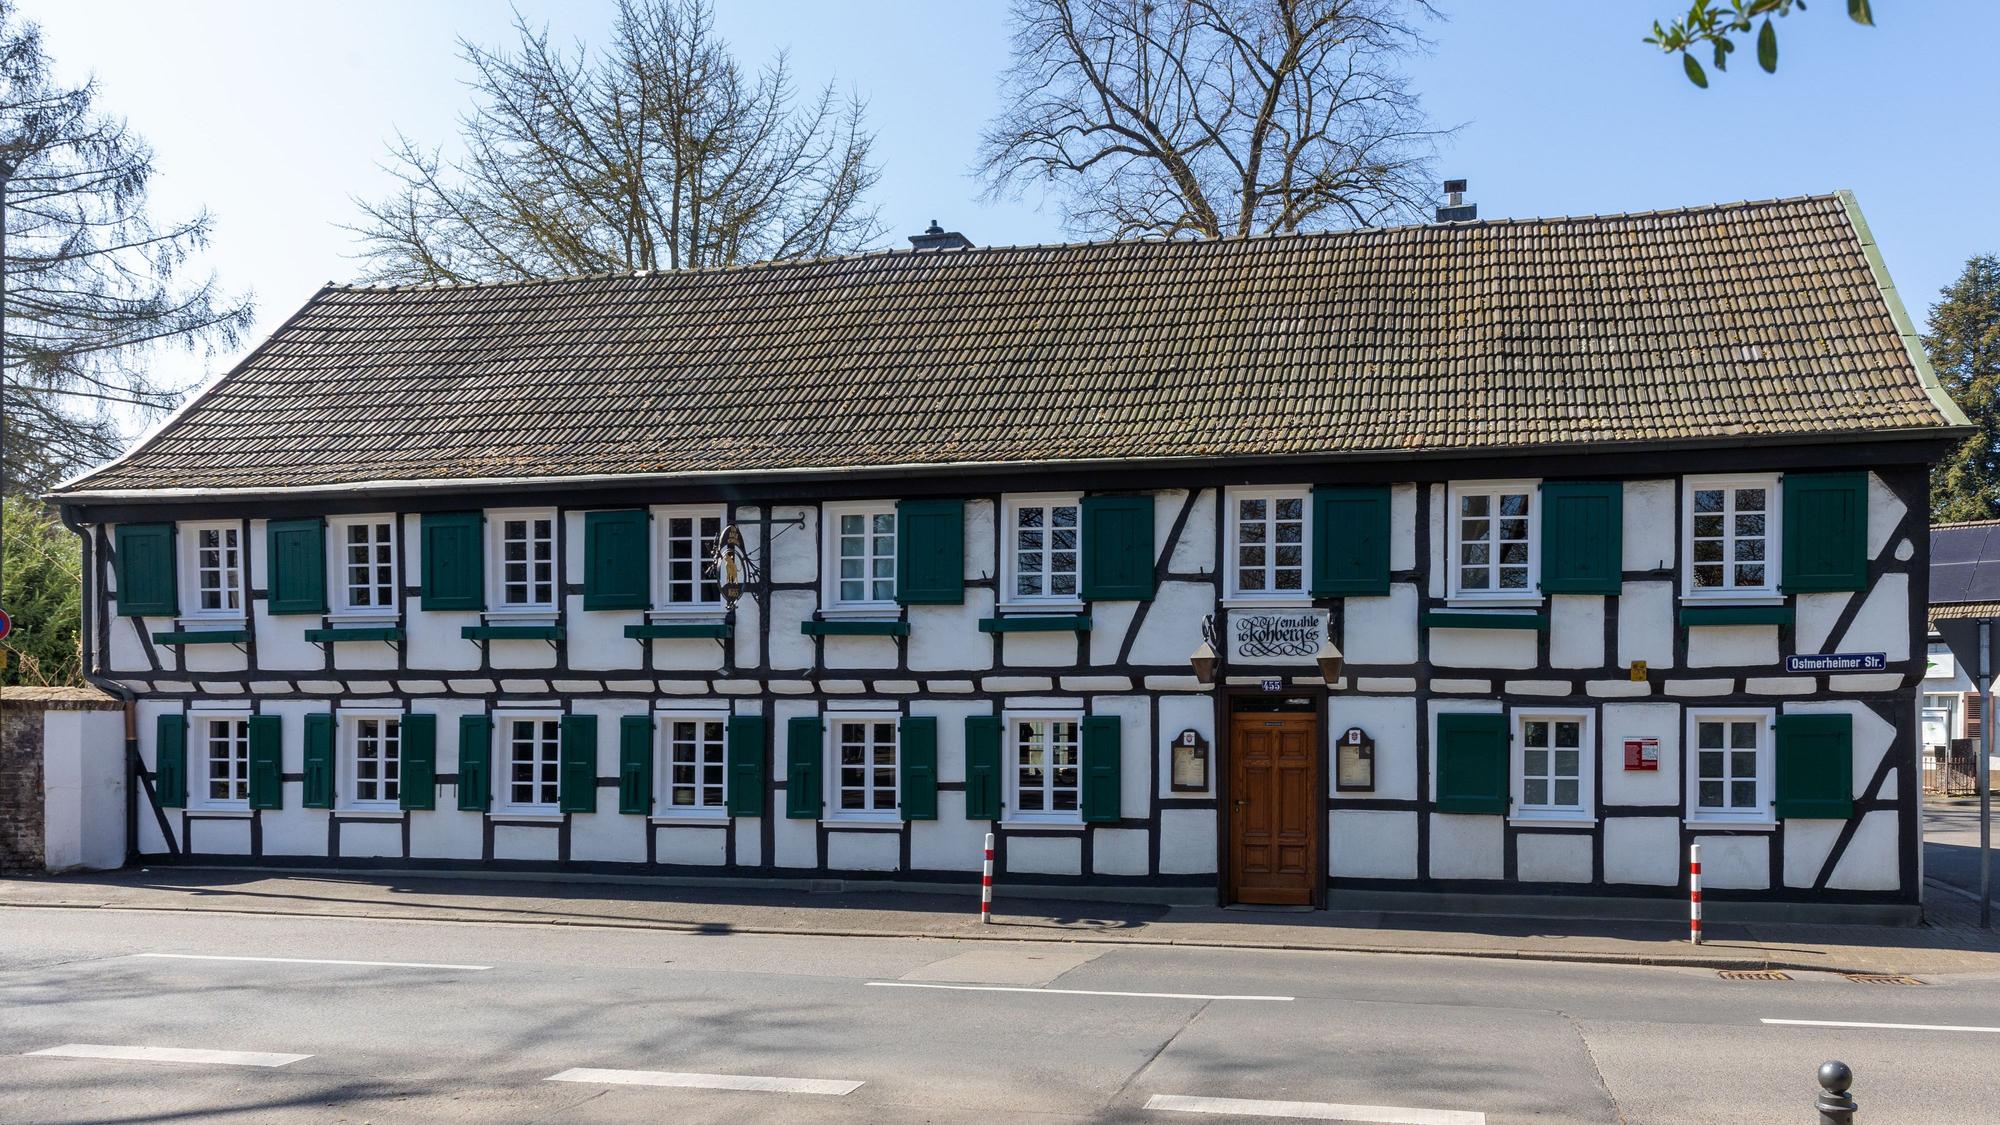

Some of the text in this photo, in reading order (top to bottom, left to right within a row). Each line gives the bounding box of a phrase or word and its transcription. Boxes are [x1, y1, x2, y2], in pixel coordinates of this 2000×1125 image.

[1792, 656, 1882, 669] Ostmerheimer Str.
[1263, 681, 1280, 691] 455
